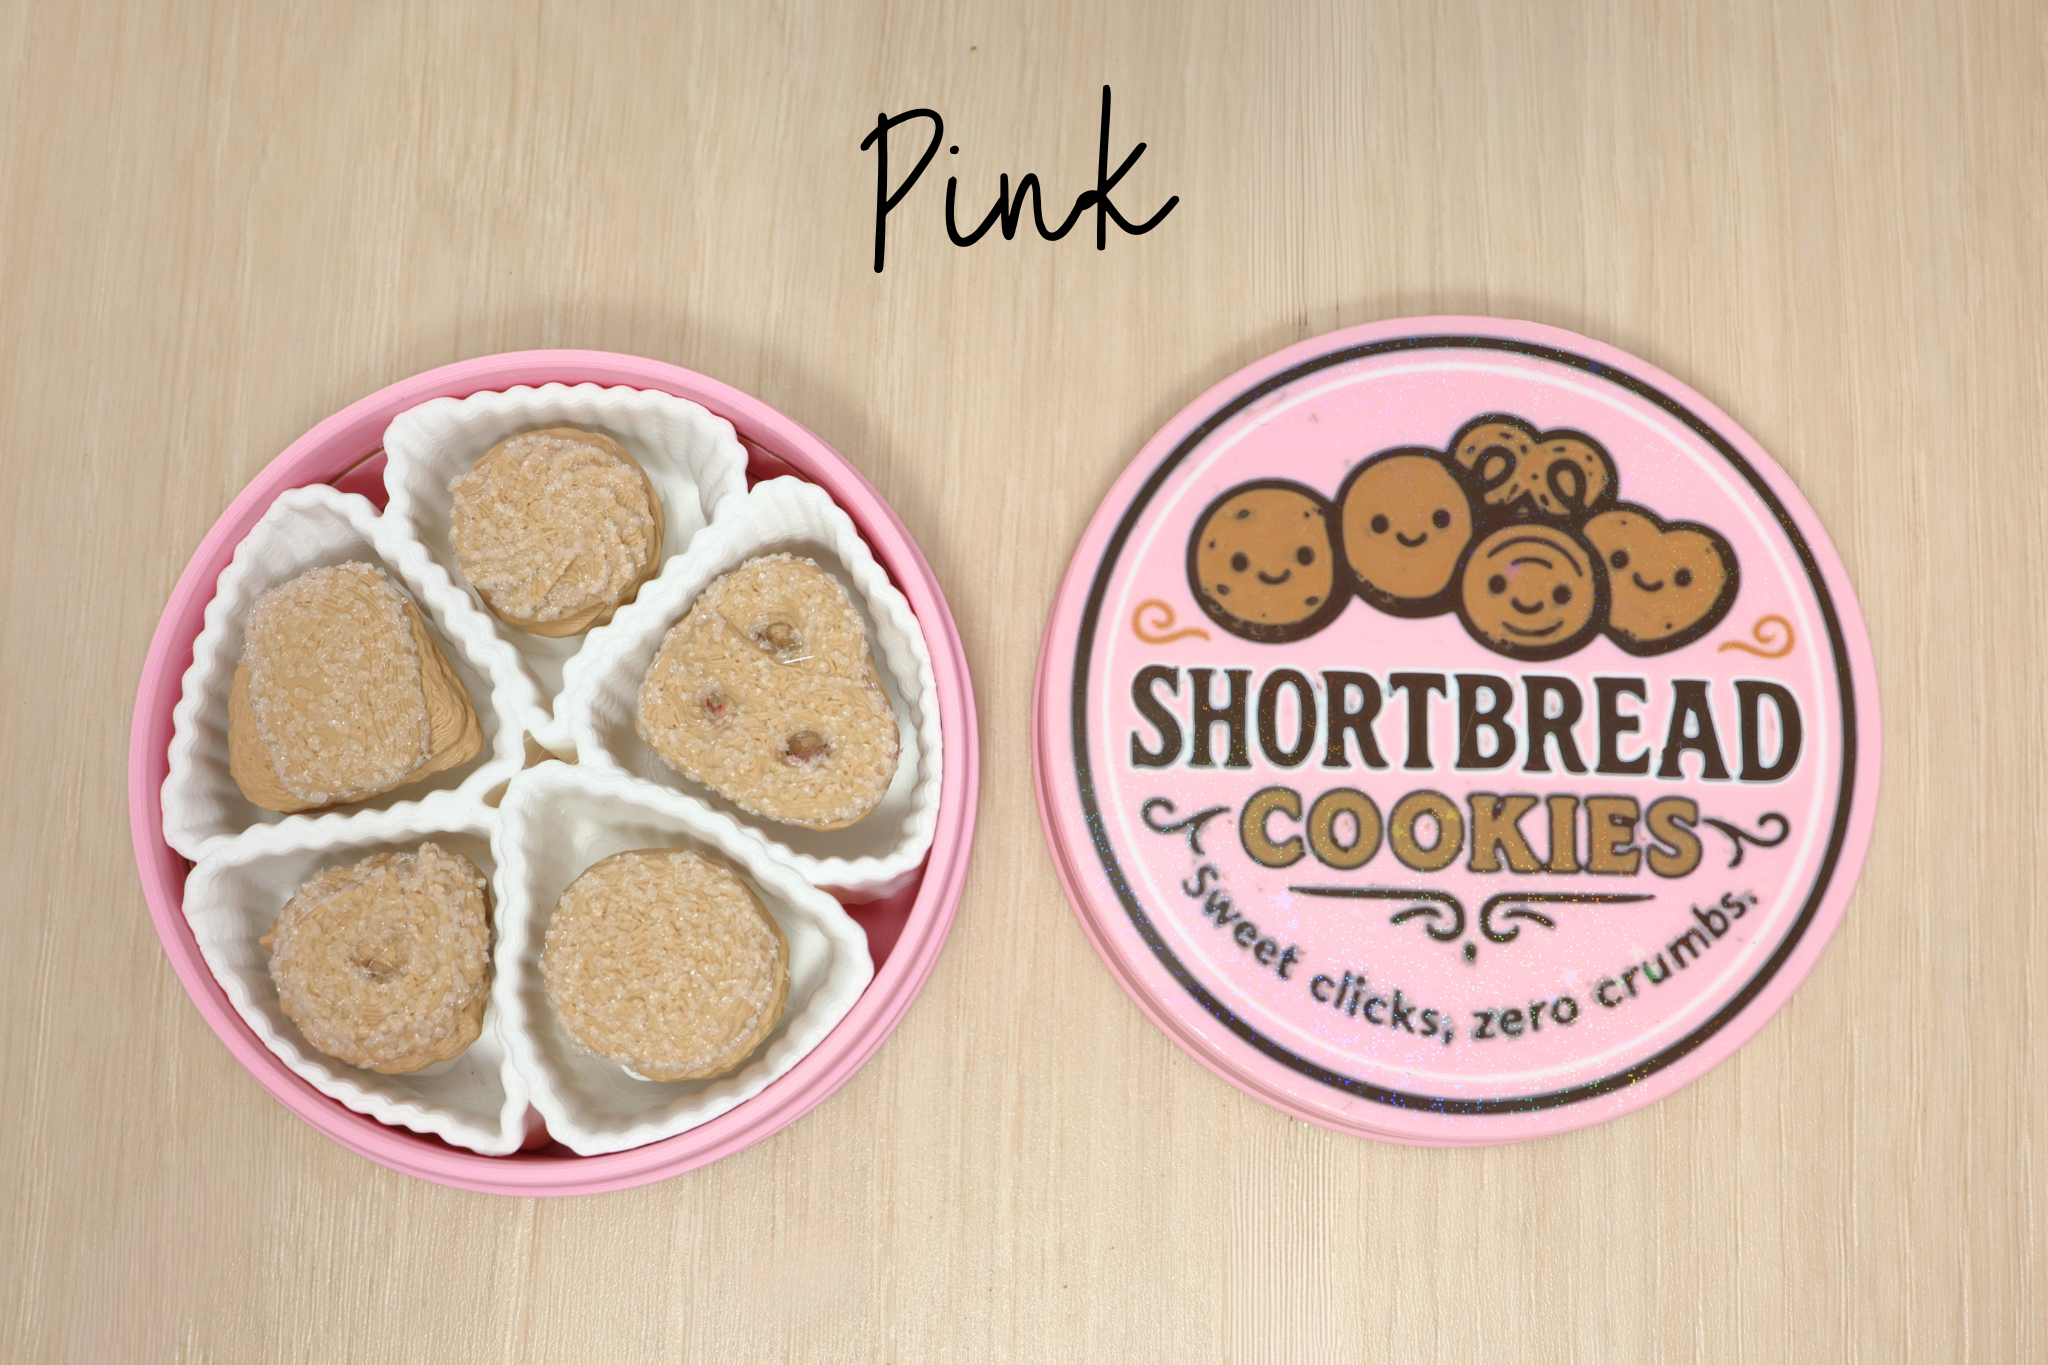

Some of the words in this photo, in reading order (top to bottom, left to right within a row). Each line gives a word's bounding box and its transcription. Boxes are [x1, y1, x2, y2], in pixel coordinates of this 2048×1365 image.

[1130, 664, 1803, 782] SHORTBREAD
[1239, 786, 1703, 878] COOKIES
[1182, 865, 1300, 980] Sweet
[1309, 970, 1455, 1044] clicks,
[1472, 997, 1580, 1040] zero
[1597, 890, 1761, 1009] crumbs.
